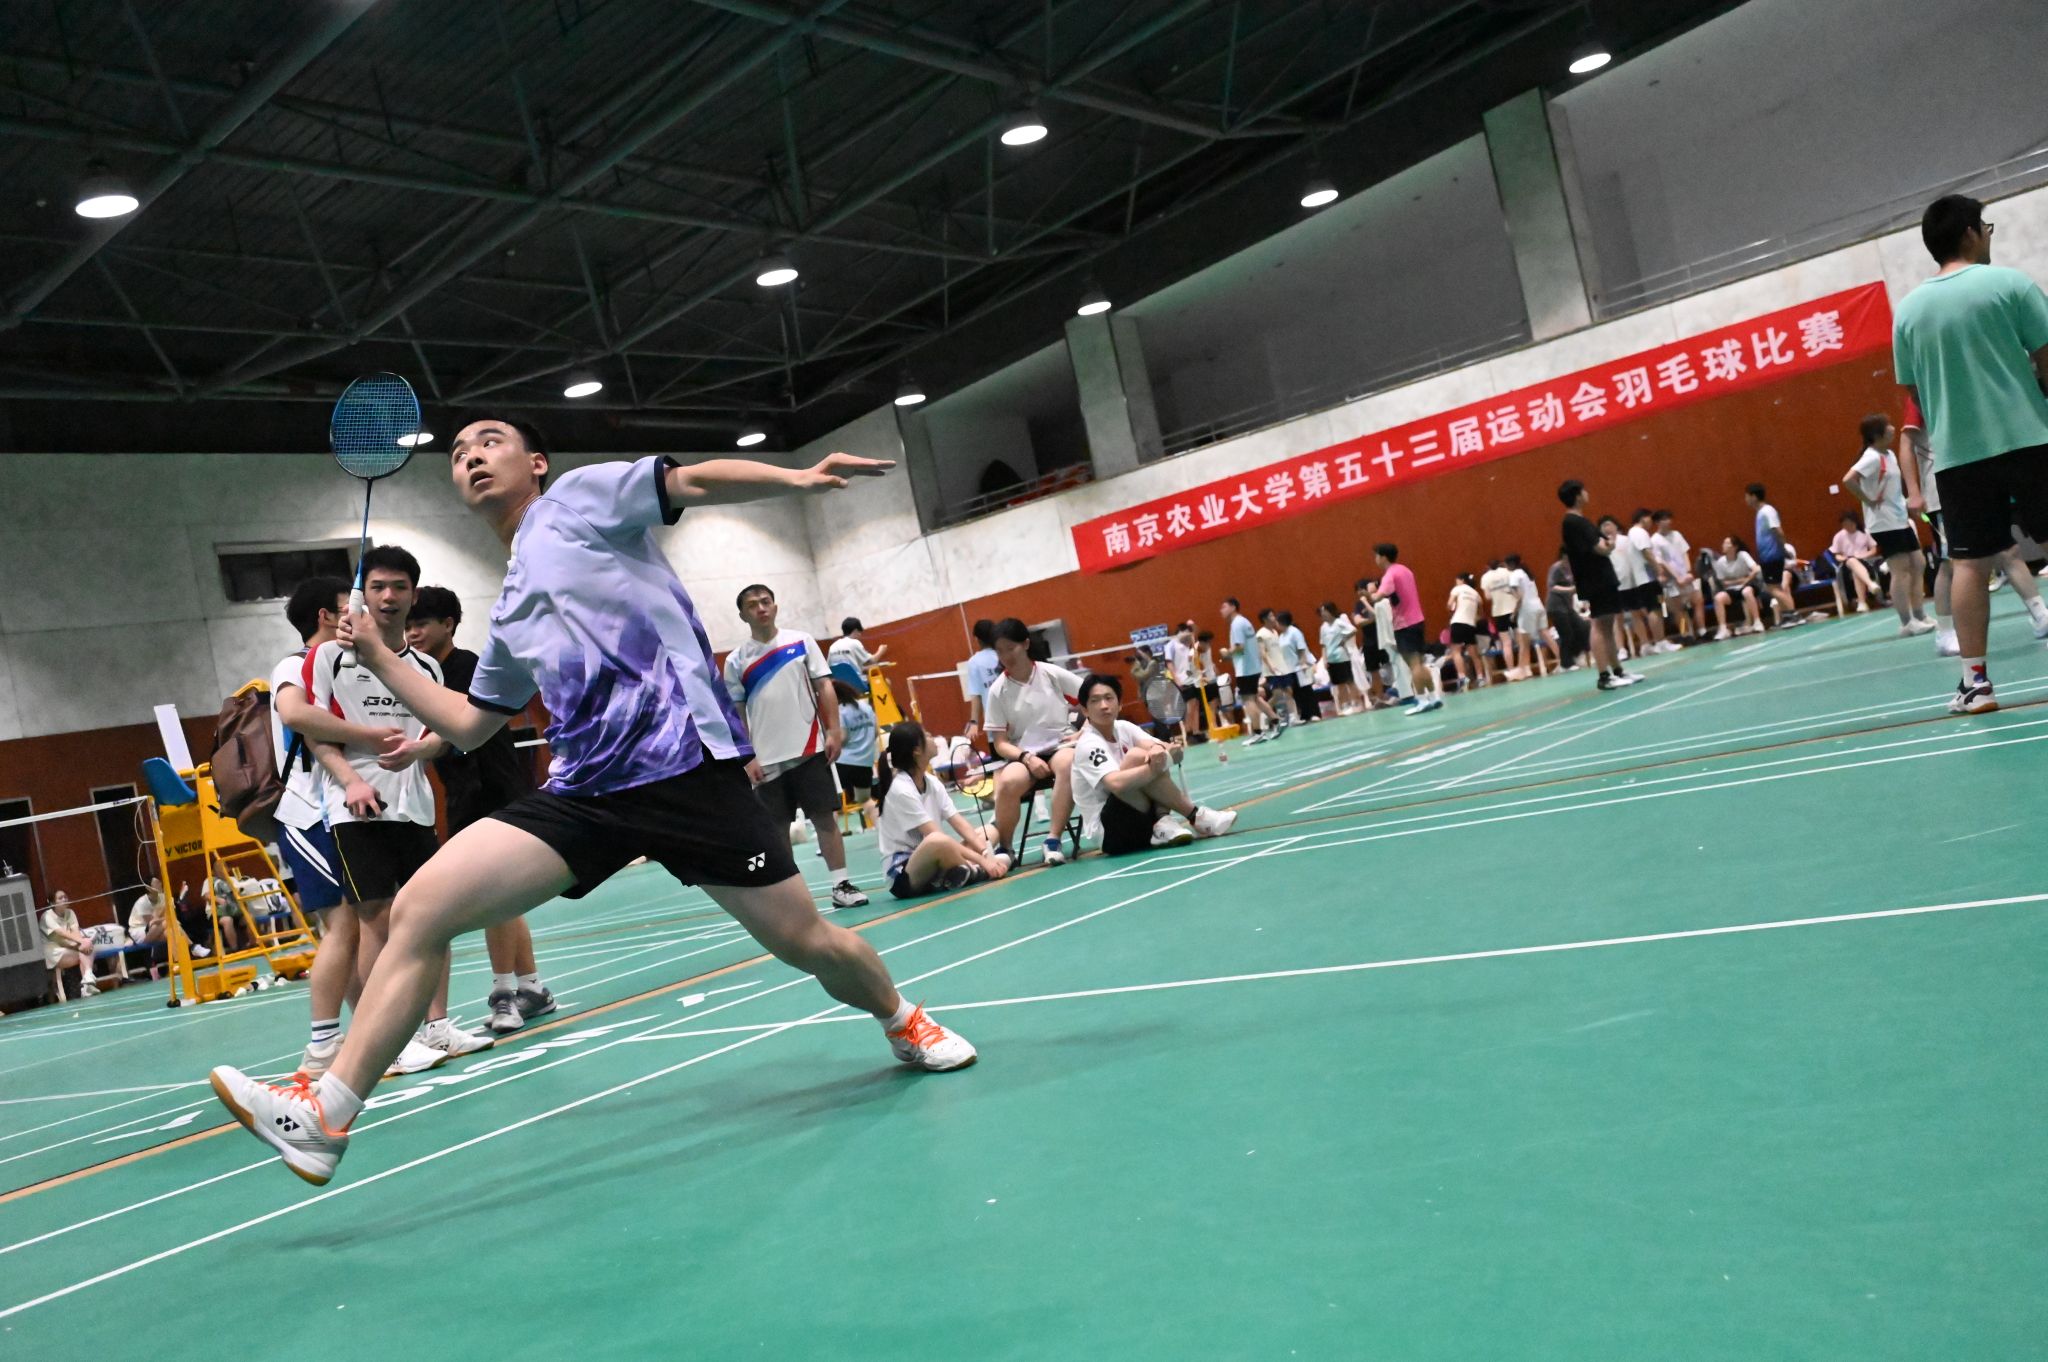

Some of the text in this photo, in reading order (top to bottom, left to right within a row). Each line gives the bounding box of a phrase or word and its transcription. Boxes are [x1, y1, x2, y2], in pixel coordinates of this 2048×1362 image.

[1102, 310, 1844, 557] 南京农业大学第五十三届运动会羽毛球比赛
